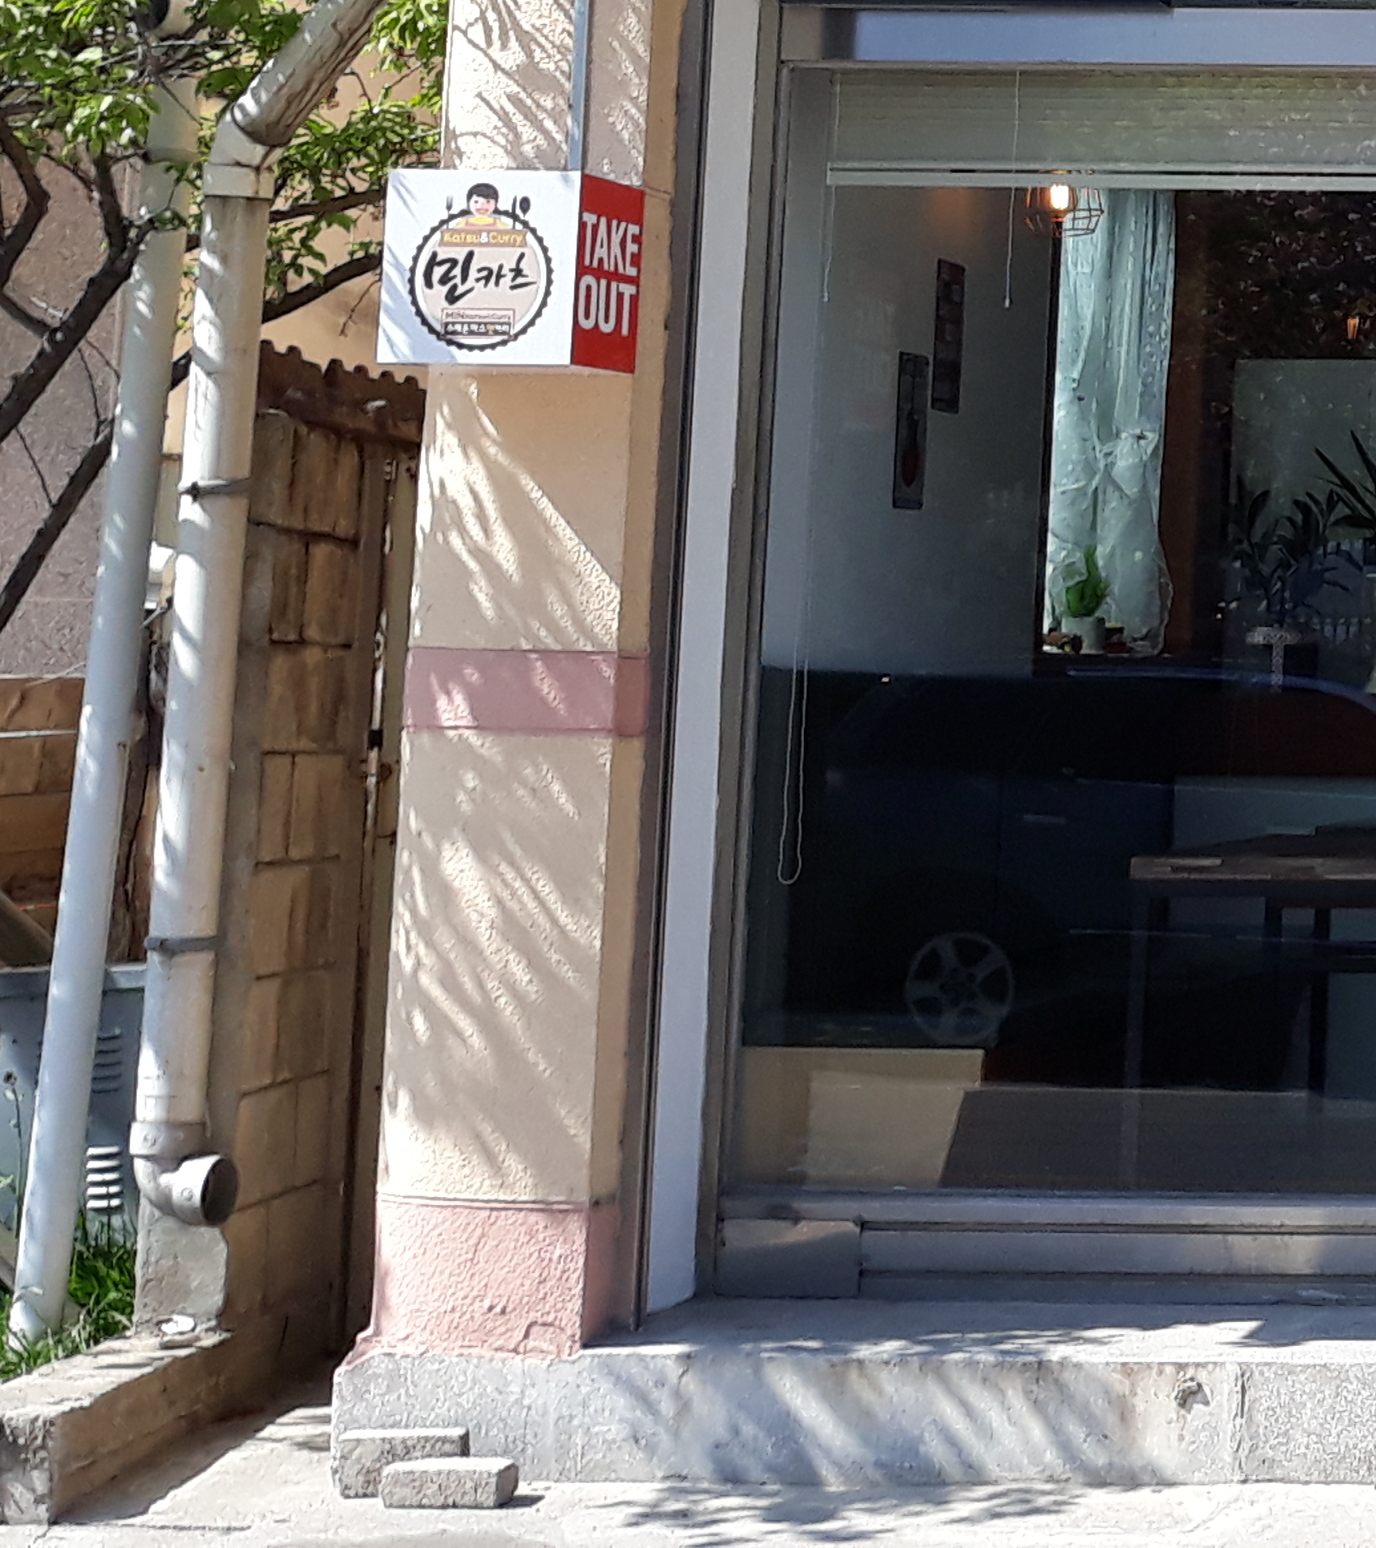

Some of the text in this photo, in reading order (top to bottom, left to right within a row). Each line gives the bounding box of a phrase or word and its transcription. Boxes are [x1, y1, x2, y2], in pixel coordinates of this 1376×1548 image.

[580, 210, 640, 278] TAKE
[422, 249, 538, 306] 민카츠
[576, 274, 637, 338] OUT
